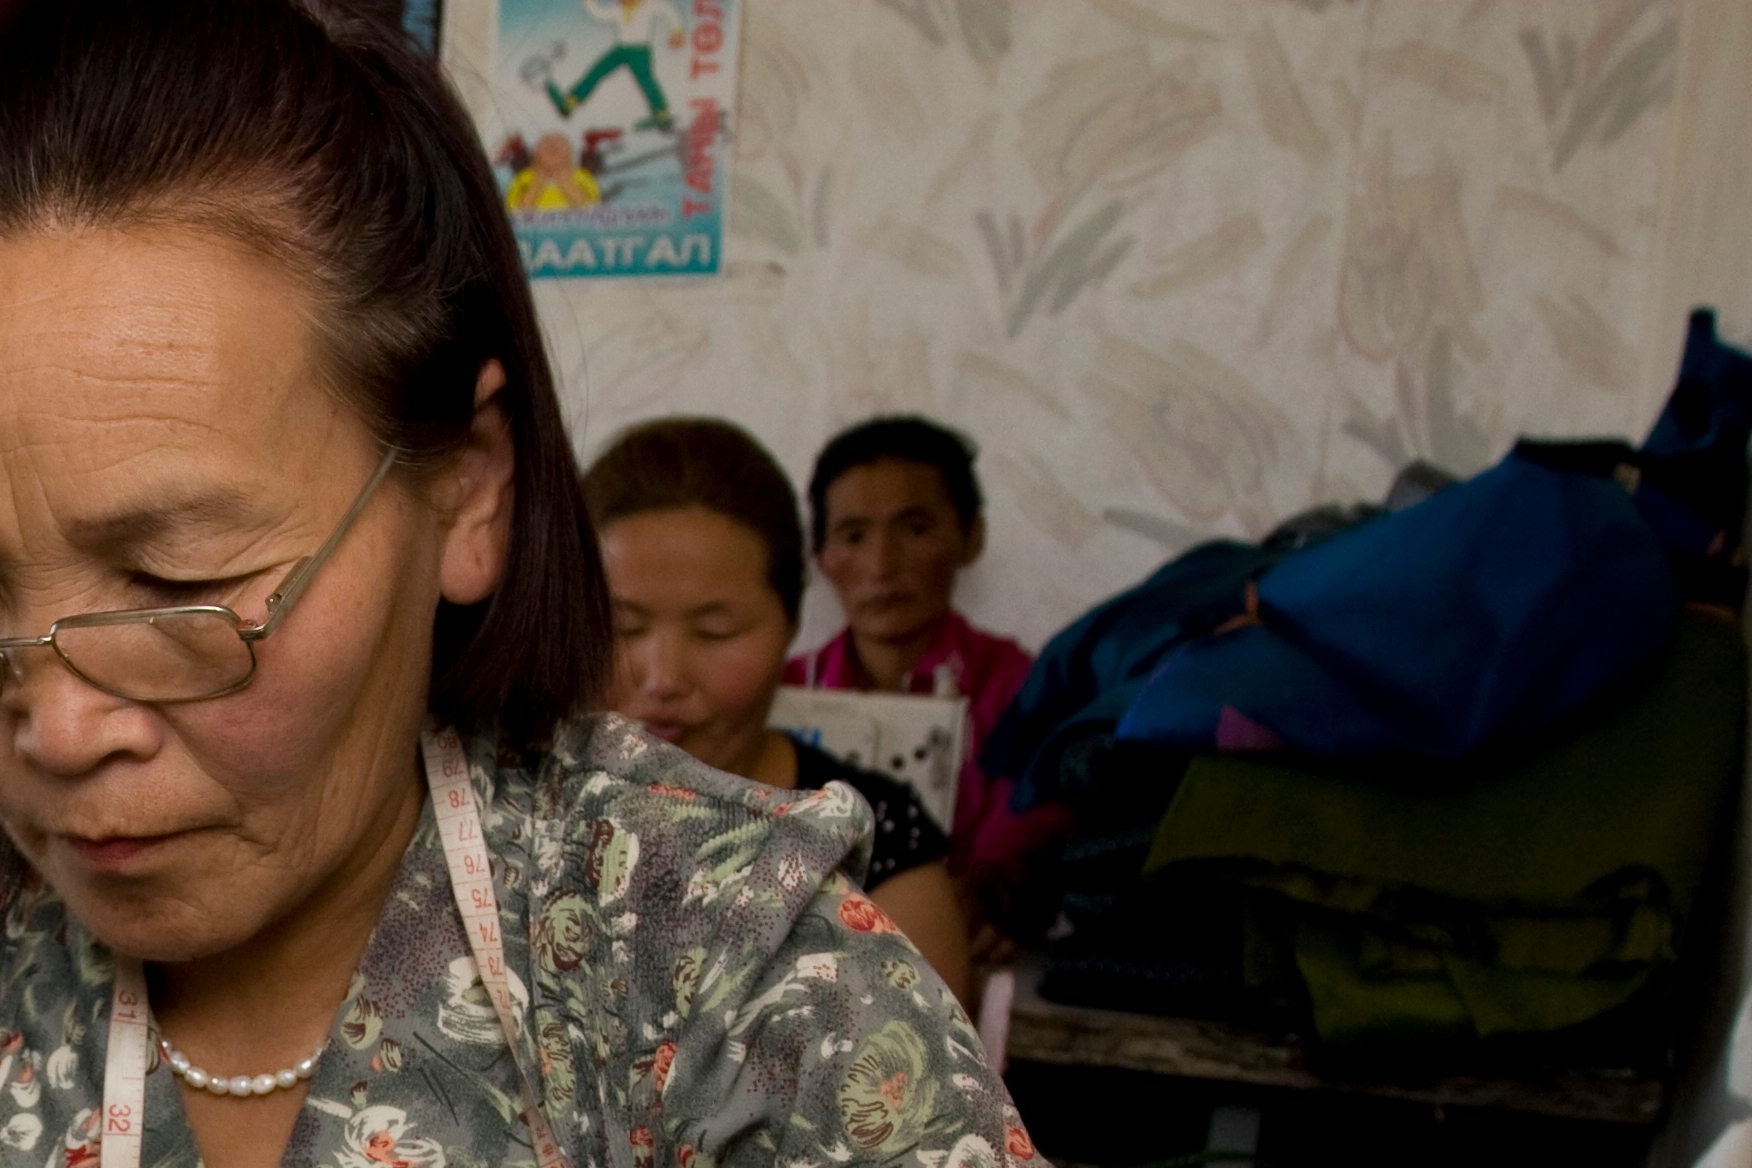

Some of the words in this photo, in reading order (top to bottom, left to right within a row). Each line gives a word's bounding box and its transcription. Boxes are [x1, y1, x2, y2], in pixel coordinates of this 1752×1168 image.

[441, 758, 464, 778] 79
[448, 787, 470, 809] 78
[458, 819, 479, 842] 77
[464, 853, 486, 875] 76
[471, 887, 493, 909] 75
[479, 921, 499, 943] 74
[488, 956, 504, 976] 73
[117, 989, 139, 1019] 31
[108, 1104, 132, 1133] 32
